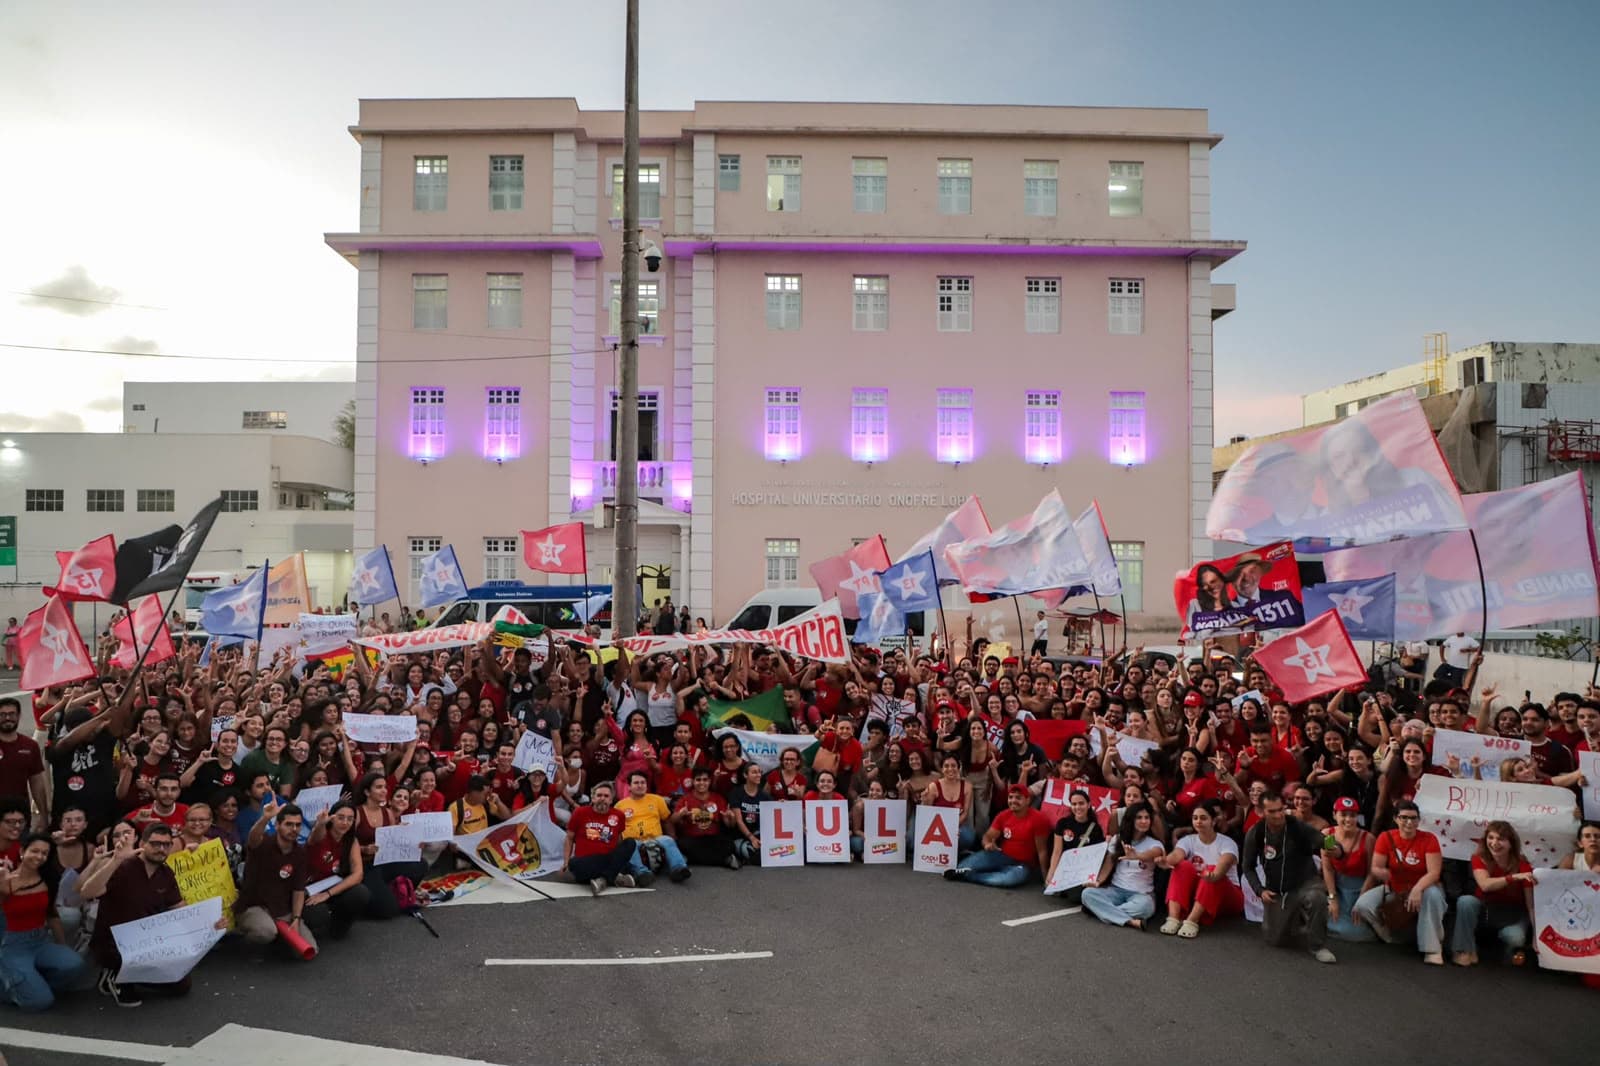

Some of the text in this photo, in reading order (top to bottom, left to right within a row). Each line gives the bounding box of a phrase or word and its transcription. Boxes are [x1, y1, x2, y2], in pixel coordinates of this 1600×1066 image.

[732, 493, 788, 506] HOSPITAL
[793, 493, 882, 507] UNIVERSITARIO
[889, 494, 937, 507] ONOFRE
[1252, 598, 1295, 623] 1311
[815, 806, 841, 837] U
[878, 806, 897, 837] L
[1528, 803, 1559, 816] COMO
[773, 808, 794, 839] L
[920, 813, 953, 847] A
[831, 842, 842, 853] 13
[938, 853, 950, 865] 13
